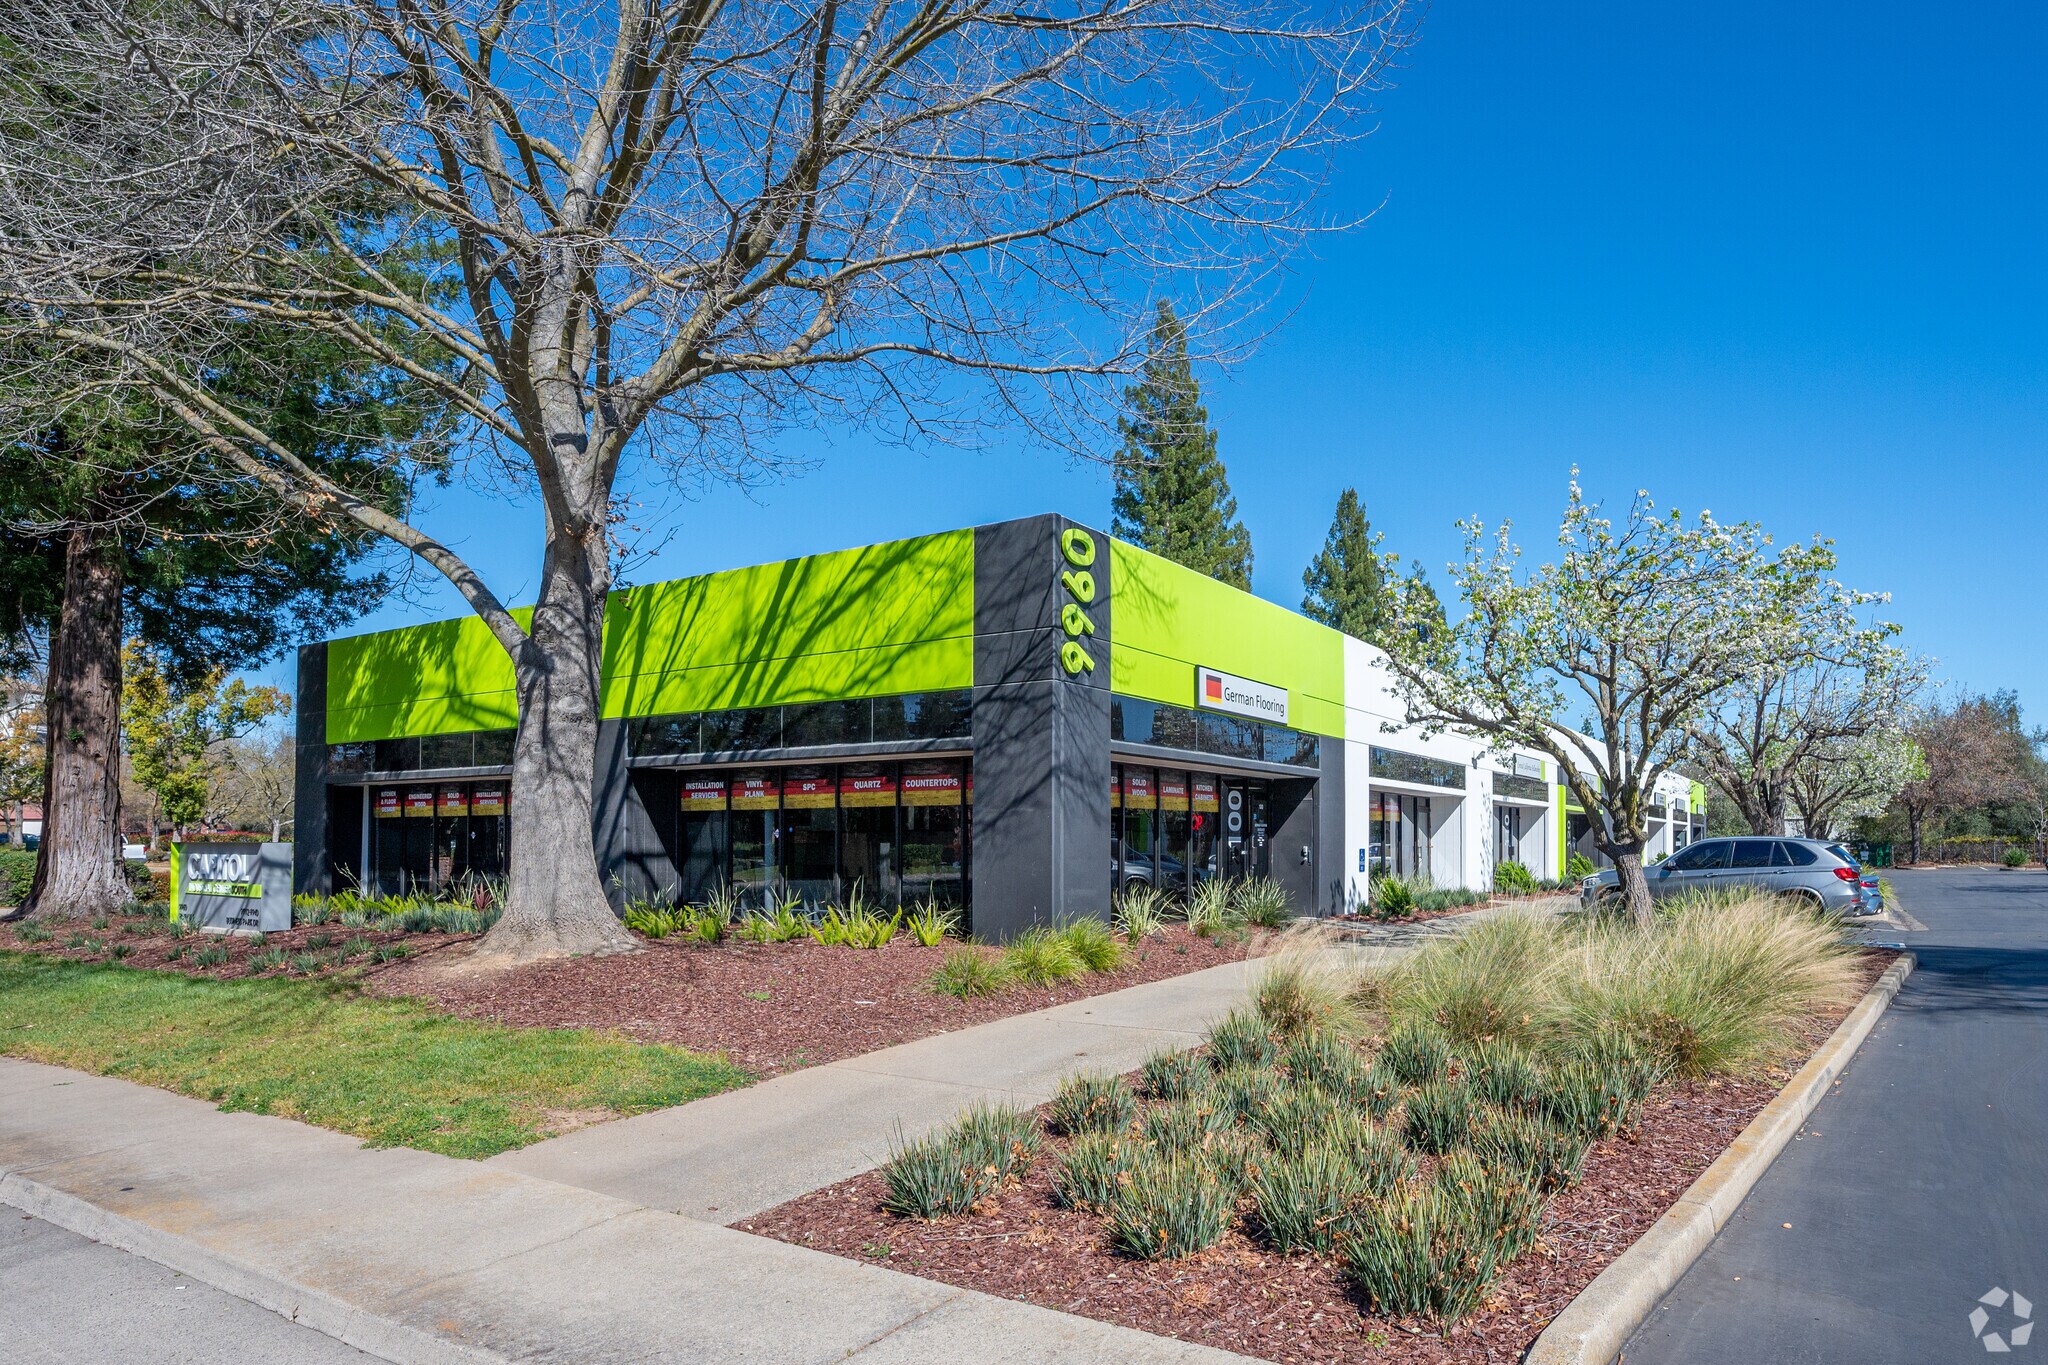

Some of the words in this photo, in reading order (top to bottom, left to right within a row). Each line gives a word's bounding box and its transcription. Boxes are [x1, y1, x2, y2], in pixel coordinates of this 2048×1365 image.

[1061, 528, 1096, 674] 9960
[1224, 687, 1254, 707] German
[1256, 695, 1285, 717] Flooring
[685, 781, 724, 790] INSTALLATION
[745, 780, 764, 788] VINYL
[854, 780, 881, 790] QUARTZ
[905, 778, 958, 788] COUNTERTOPS
[1132, 778, 1146, 786] SOLID
[802, 783, 816, 791] SPC
[1162, 786, 1184, 795] LAMINATE
[1196, 784, 1213, 792] KITCHEN
[690, 791, 719, 799] SERVICES
[744, 790, 764, 798] PLANK
[1132, 789, 1146, 797] WOOD
[187, 853, 250, 881] CAPITOL
